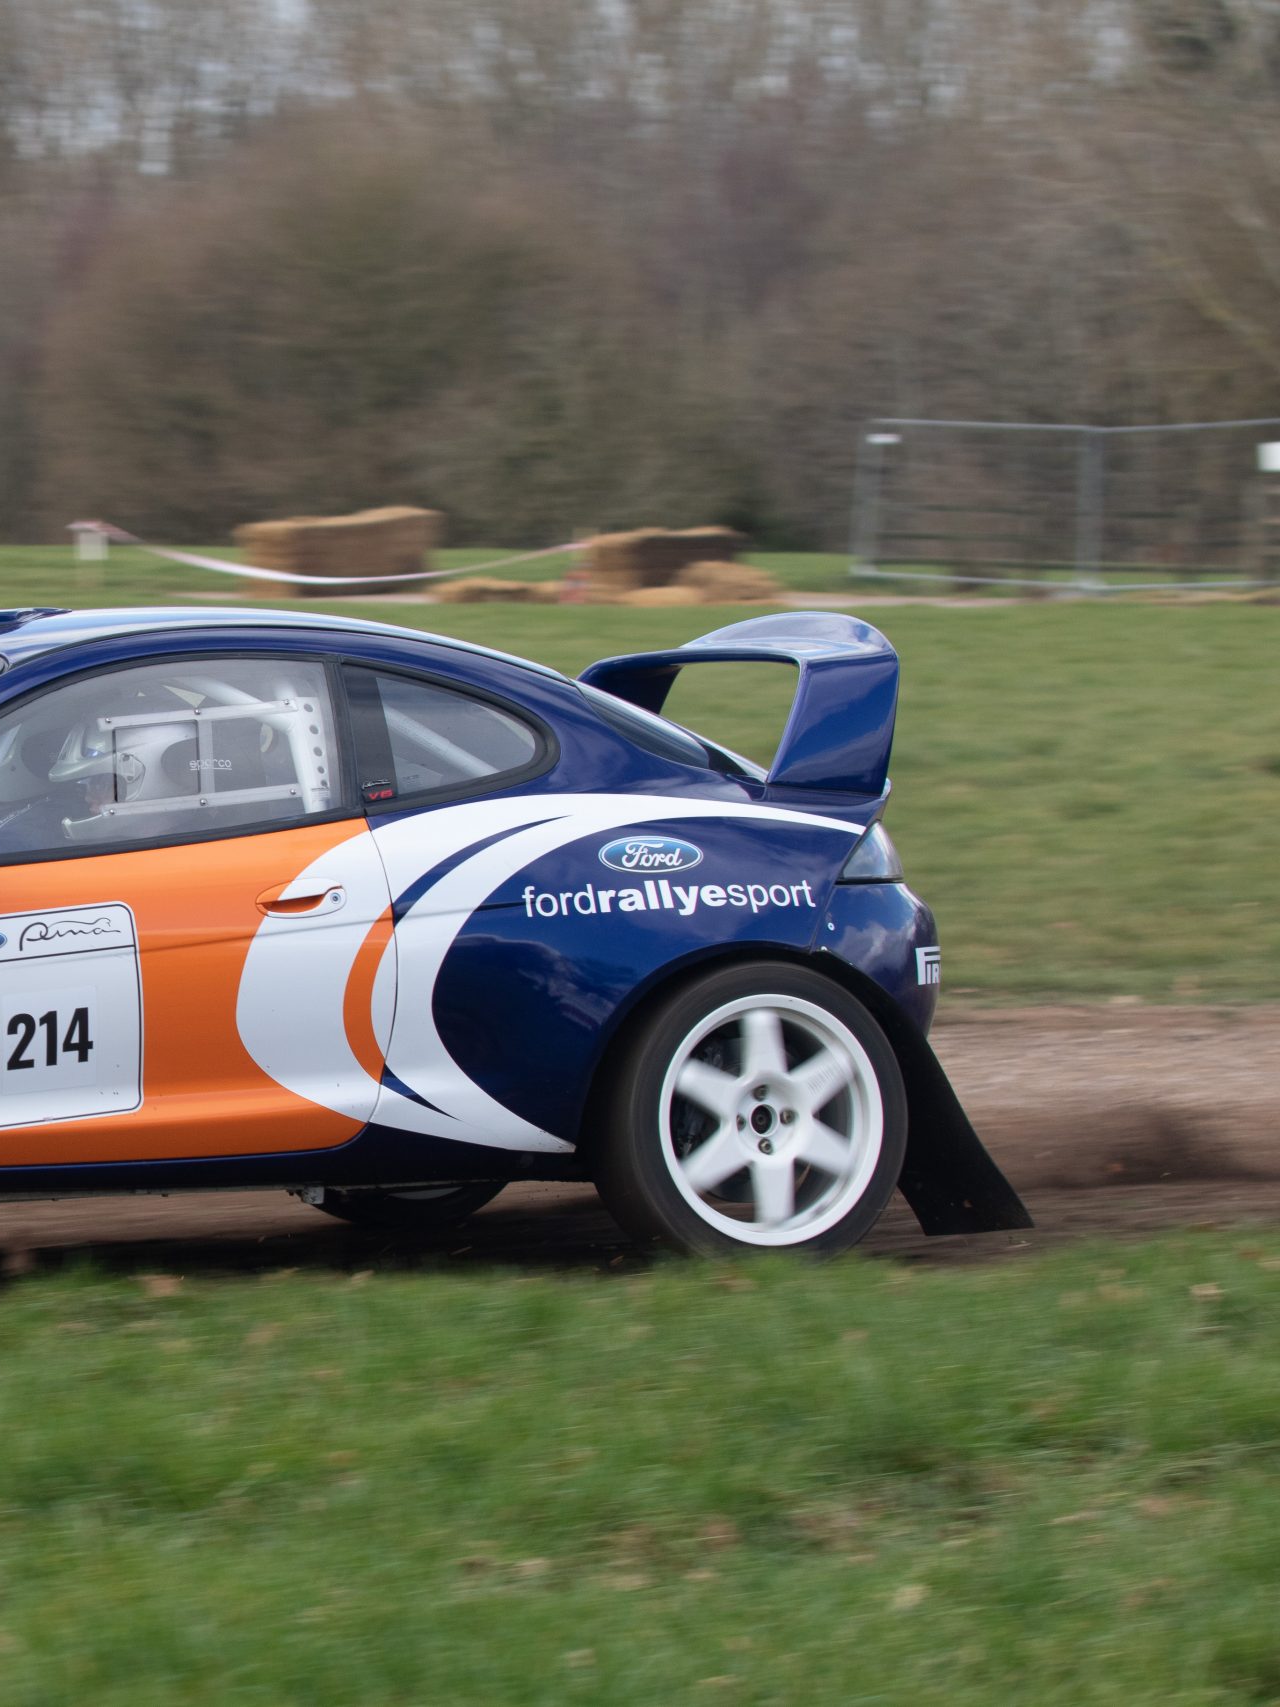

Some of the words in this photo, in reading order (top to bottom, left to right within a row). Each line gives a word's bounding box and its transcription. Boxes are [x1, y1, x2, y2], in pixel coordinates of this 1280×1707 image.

[621, 841, 683, 868] Ford
[521, 879, 816, 917] fordrallyesport
[6, 1006, 94, 1071] 214
